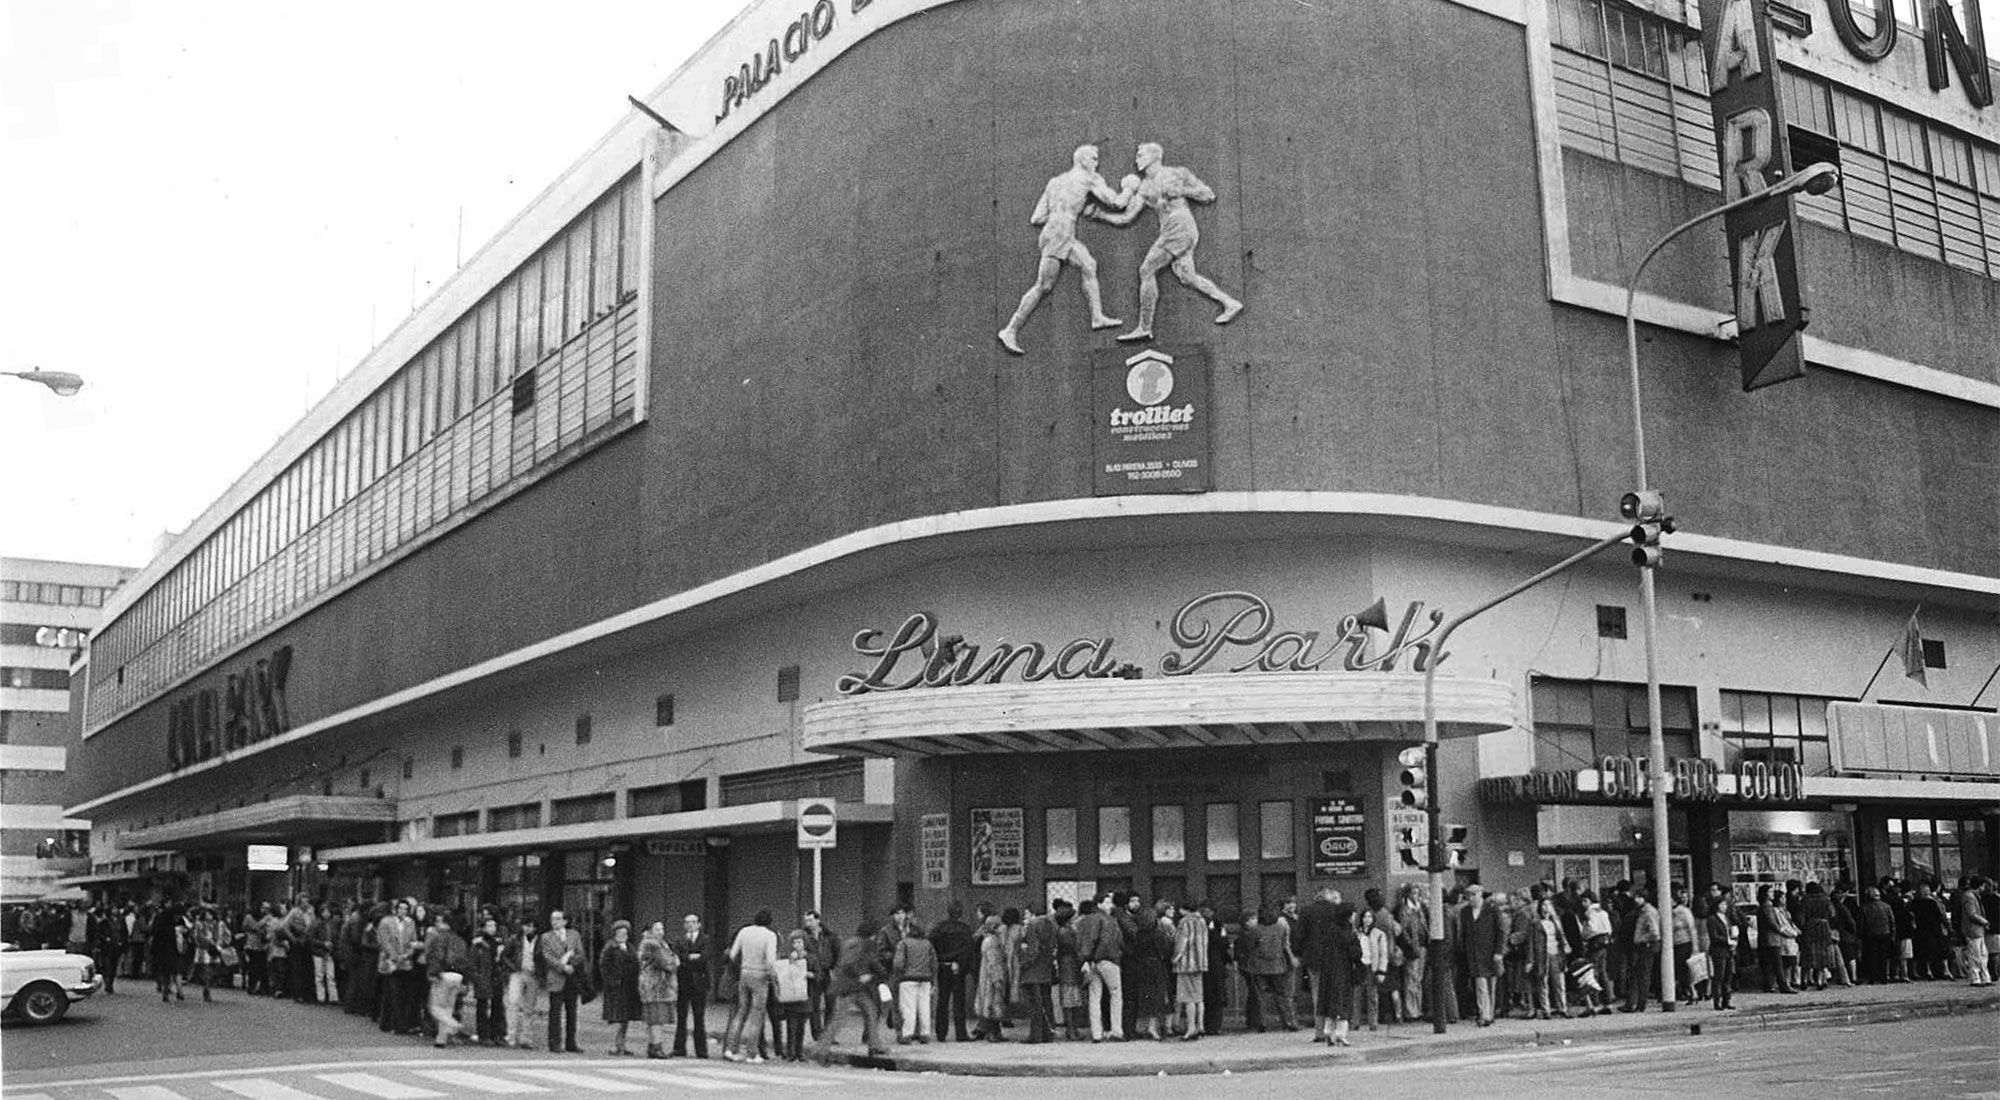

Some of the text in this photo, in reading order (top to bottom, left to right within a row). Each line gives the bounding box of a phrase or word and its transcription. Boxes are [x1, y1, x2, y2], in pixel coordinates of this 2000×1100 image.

[716, 0, 834, 125] PALACIO
[1110, 404, 1195, 426] trolliet
[836, 611, 1118, 695] Luna
[1159, 590, 1451, 676] Park
